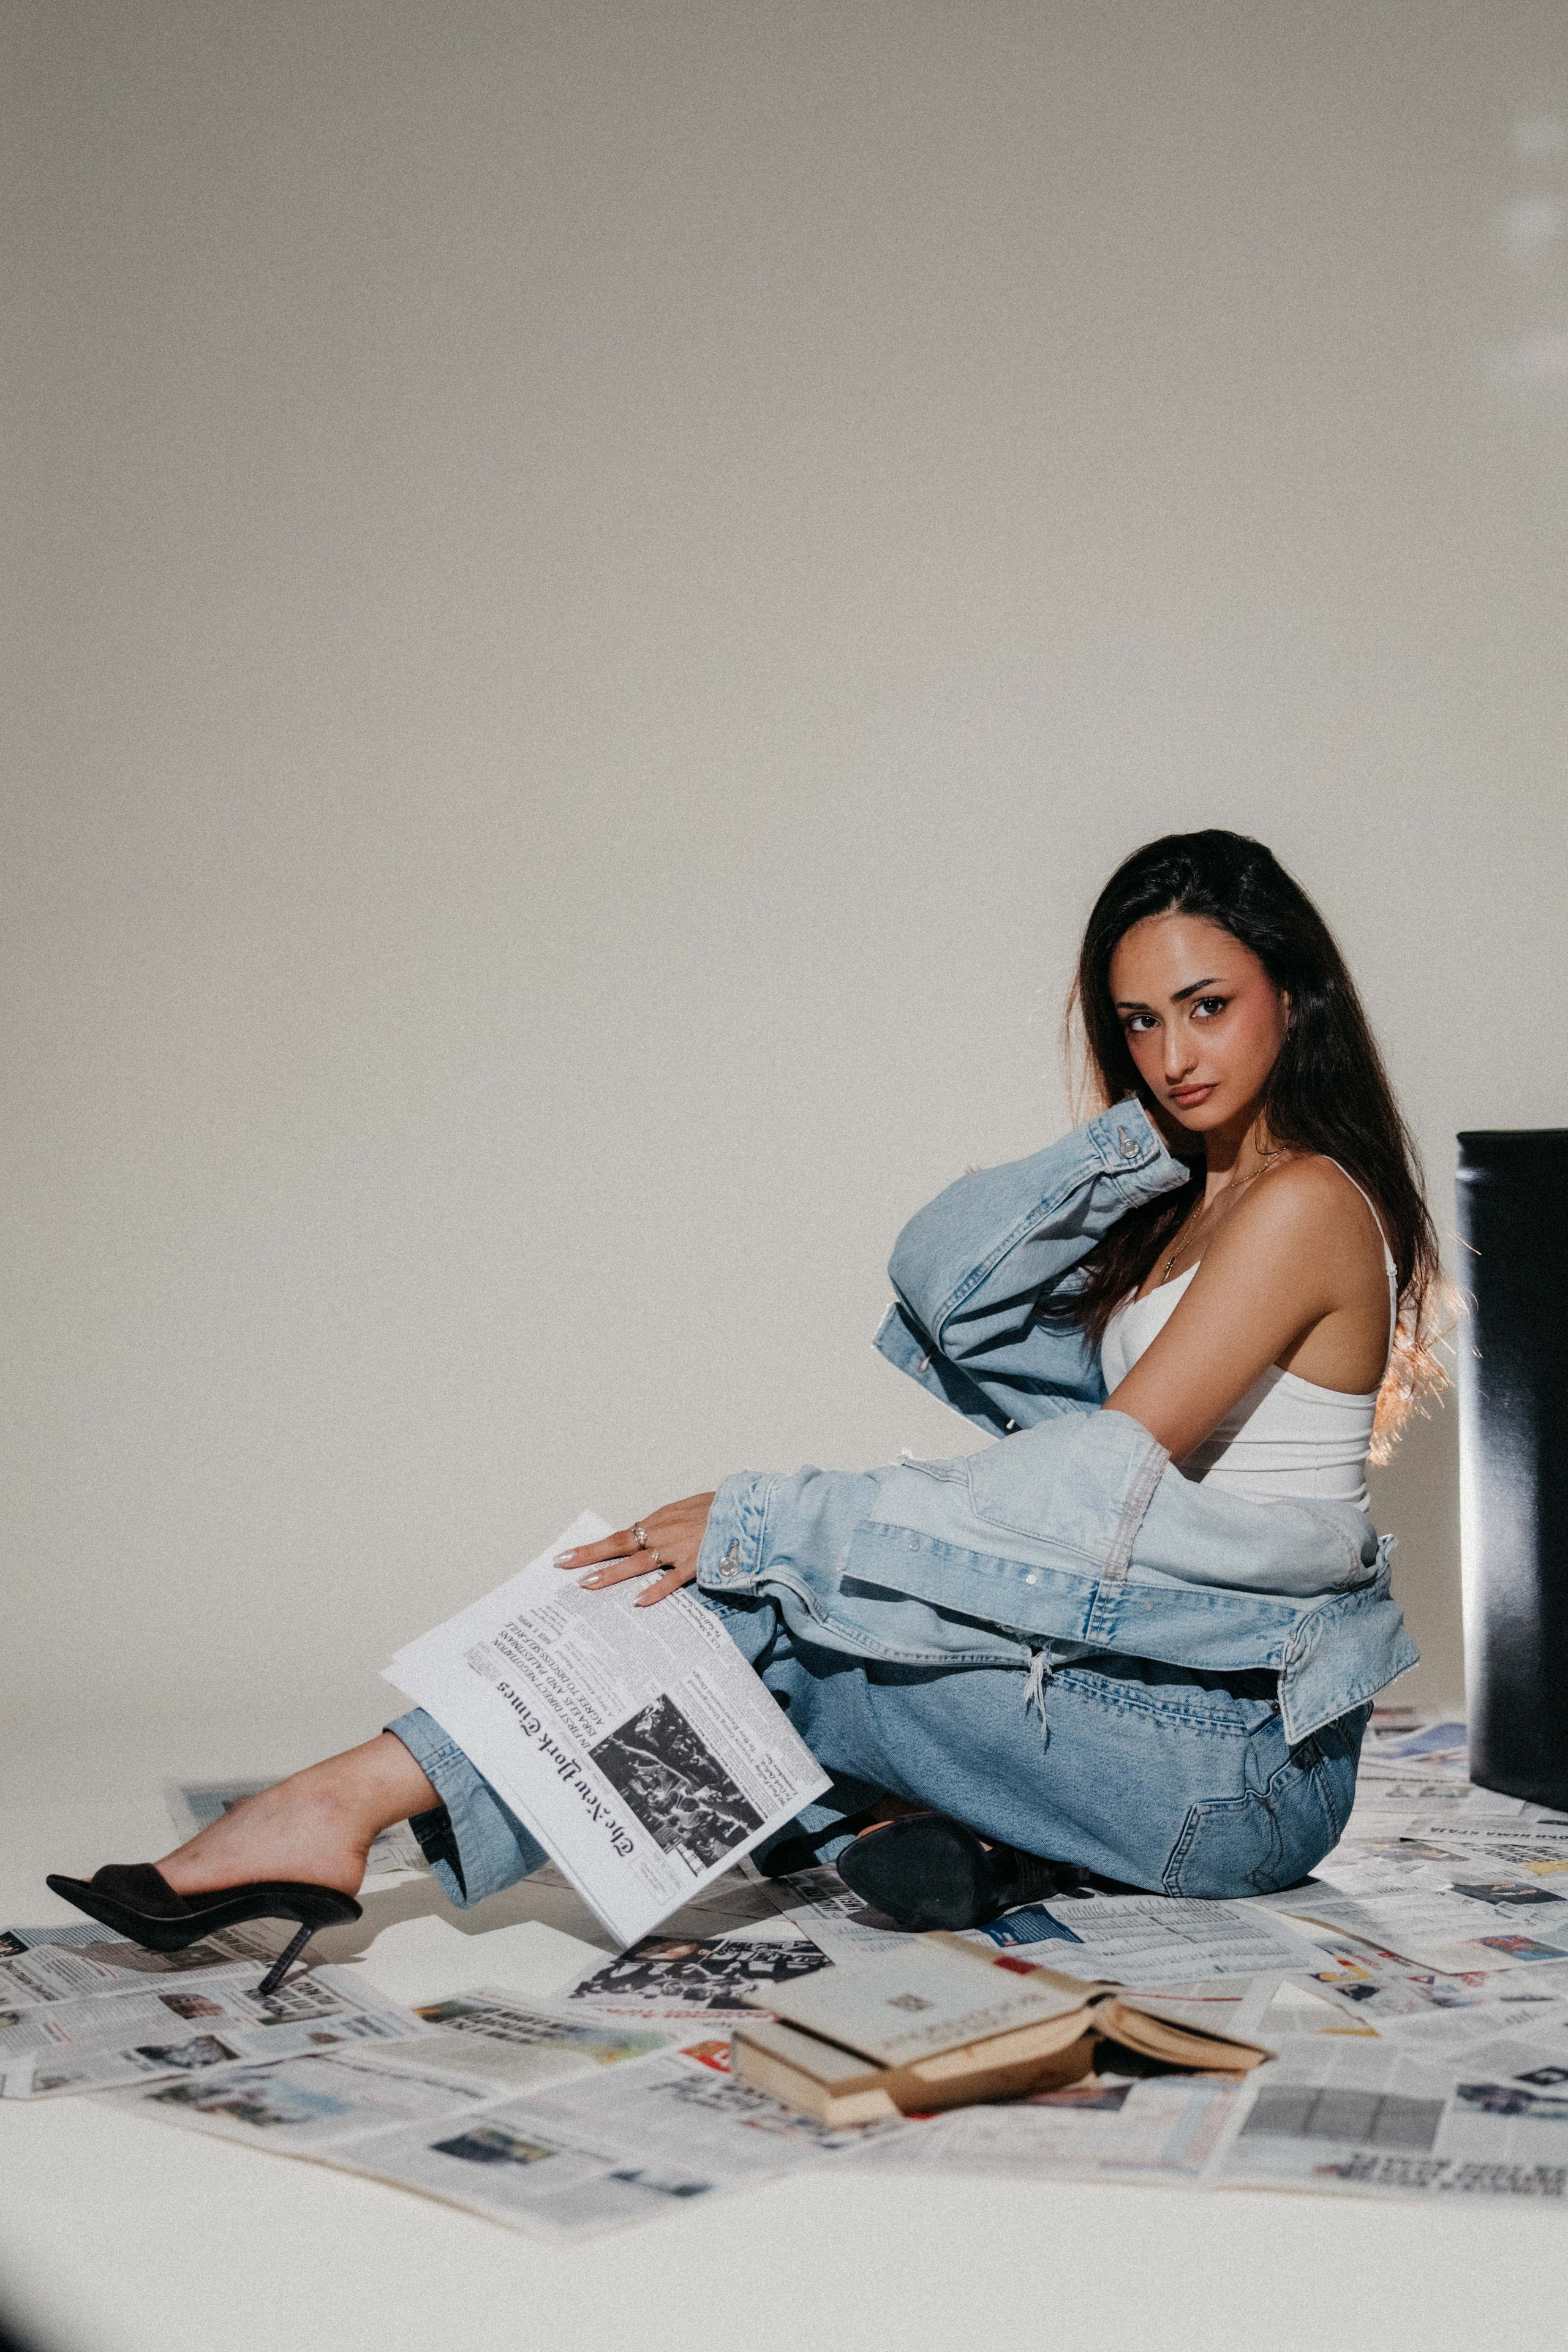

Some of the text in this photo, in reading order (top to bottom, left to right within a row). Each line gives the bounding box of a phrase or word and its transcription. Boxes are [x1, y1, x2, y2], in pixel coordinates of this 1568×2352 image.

[685, 1608, 706, 1632] Shopping
[703, 1618, 714, 1630] Sell
[503, 1621, 543, 1653] SELF-RULE
[497, 1630, 548, 1675] PALESTINIANS
[538, 1652, 570, 1683] DISCUSS
[533, 1682, 564, 1713] DIRECT
[545, 1676, 565, 1694] AND
[566, 1682, 580, 1696] TO
[496, 1681, 541, 1737] Times
[577, 1697, 604, 1725] AGREE
[686, 1678, 720, 1721] Underground
[706, 1689, 740, 1731] Experimental
[558, 1713, 583, 1739] FIRST
[562, 1696, 597, 1736] ISRAELIS
[719, 1717, 735, 1738] Going
[578, 1738, 590, 1749] IN
[738, 1730, 750, 1744] Buy
[748, 1743, 756, 1753] To
[537, 1732, 582, 1782] York
[573, 1780, 611, 1822] New
[767, 1784, 780, 1798] Pact
[785, 1792, 793, 1802] To
[604, 1819, 635, 1858] The
